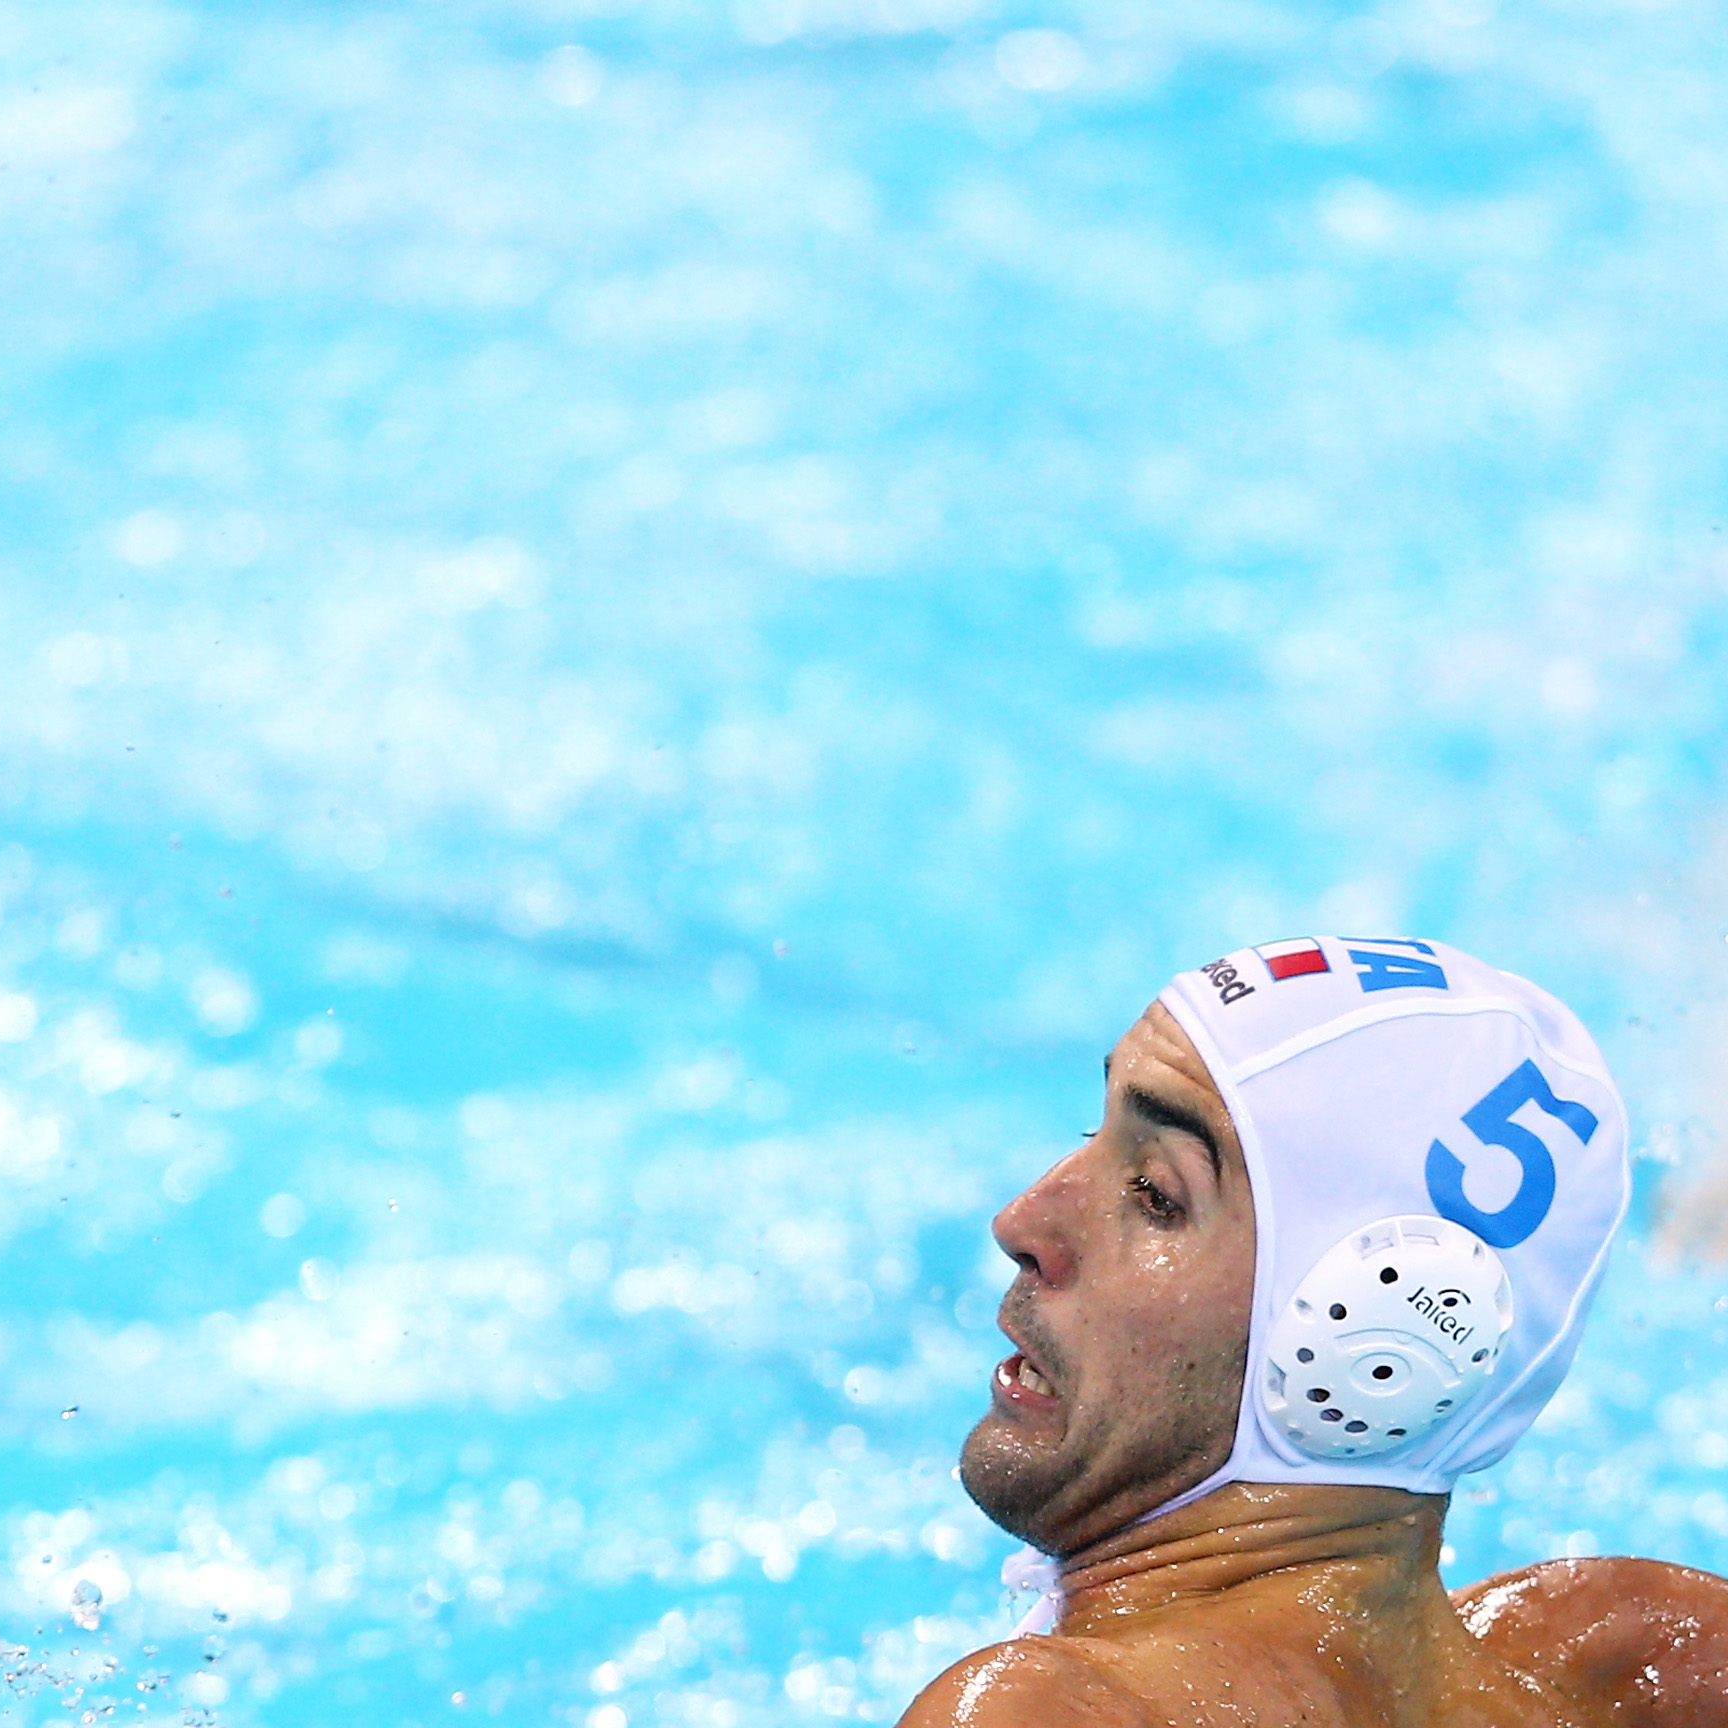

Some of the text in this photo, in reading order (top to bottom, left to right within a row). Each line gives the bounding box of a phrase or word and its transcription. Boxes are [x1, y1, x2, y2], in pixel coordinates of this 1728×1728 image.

[1337, 936, 1449, 993] TA
[1425, 1057, 1599, 1249] 5
[1406, 1286, 1475, 1346] Jaked
